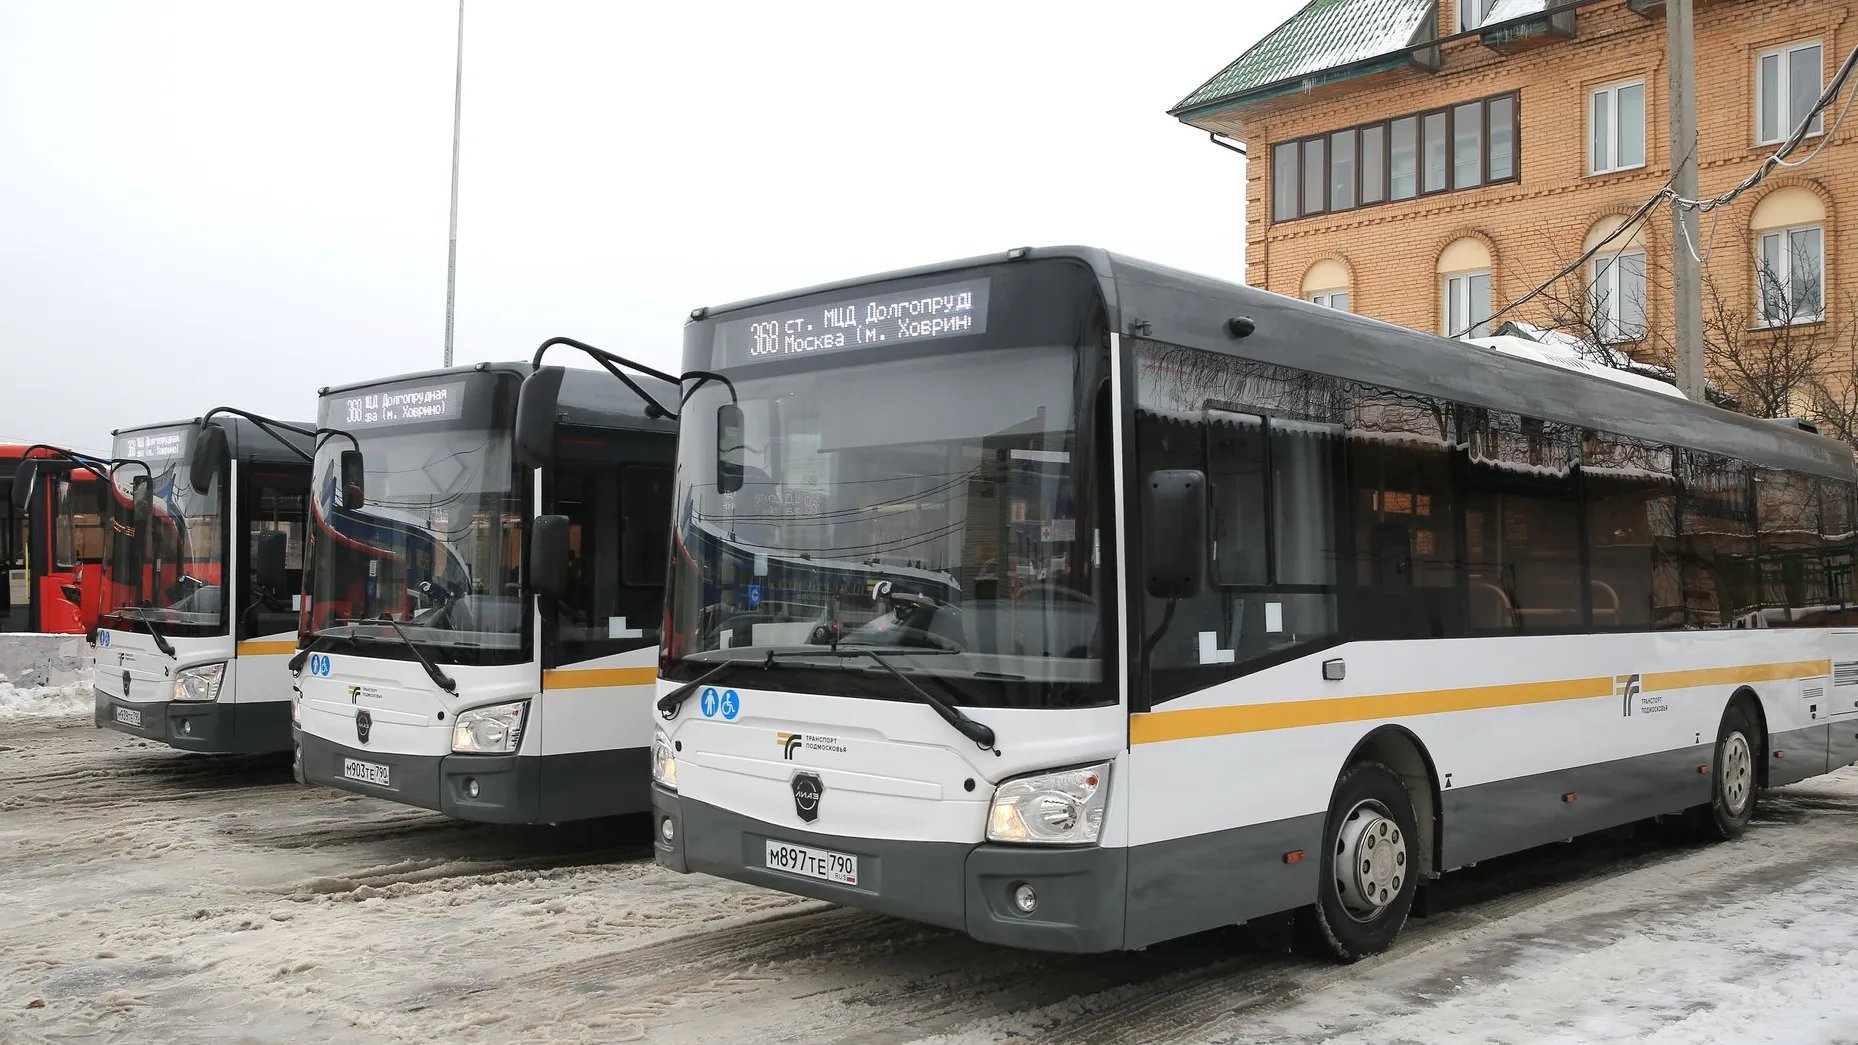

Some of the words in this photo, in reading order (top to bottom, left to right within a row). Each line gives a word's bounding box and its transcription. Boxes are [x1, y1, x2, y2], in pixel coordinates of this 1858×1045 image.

[784, 318, 813, 335] ст.
[823, 305, 857, 329] МЦД
[750, 320, 779, 356] 368
[784, 332, 846, 355] Москва
[856, 324, 887, 344] (м.
[898, 314, 973, 339] Ховрин
[382, 388, 448, 409] Долгопрудная
[402, 399, 446, 419] Ховрино)
[805, 735, 838, 744] ТРАНСПОРТ
[805, 743, 847, 753] ПОДМОСКОВЬЯ
[770, 846, 826, 876] М897ТЕ
[829, 854, 853, 874] 790
[834, 872, 847, 881] RUS
